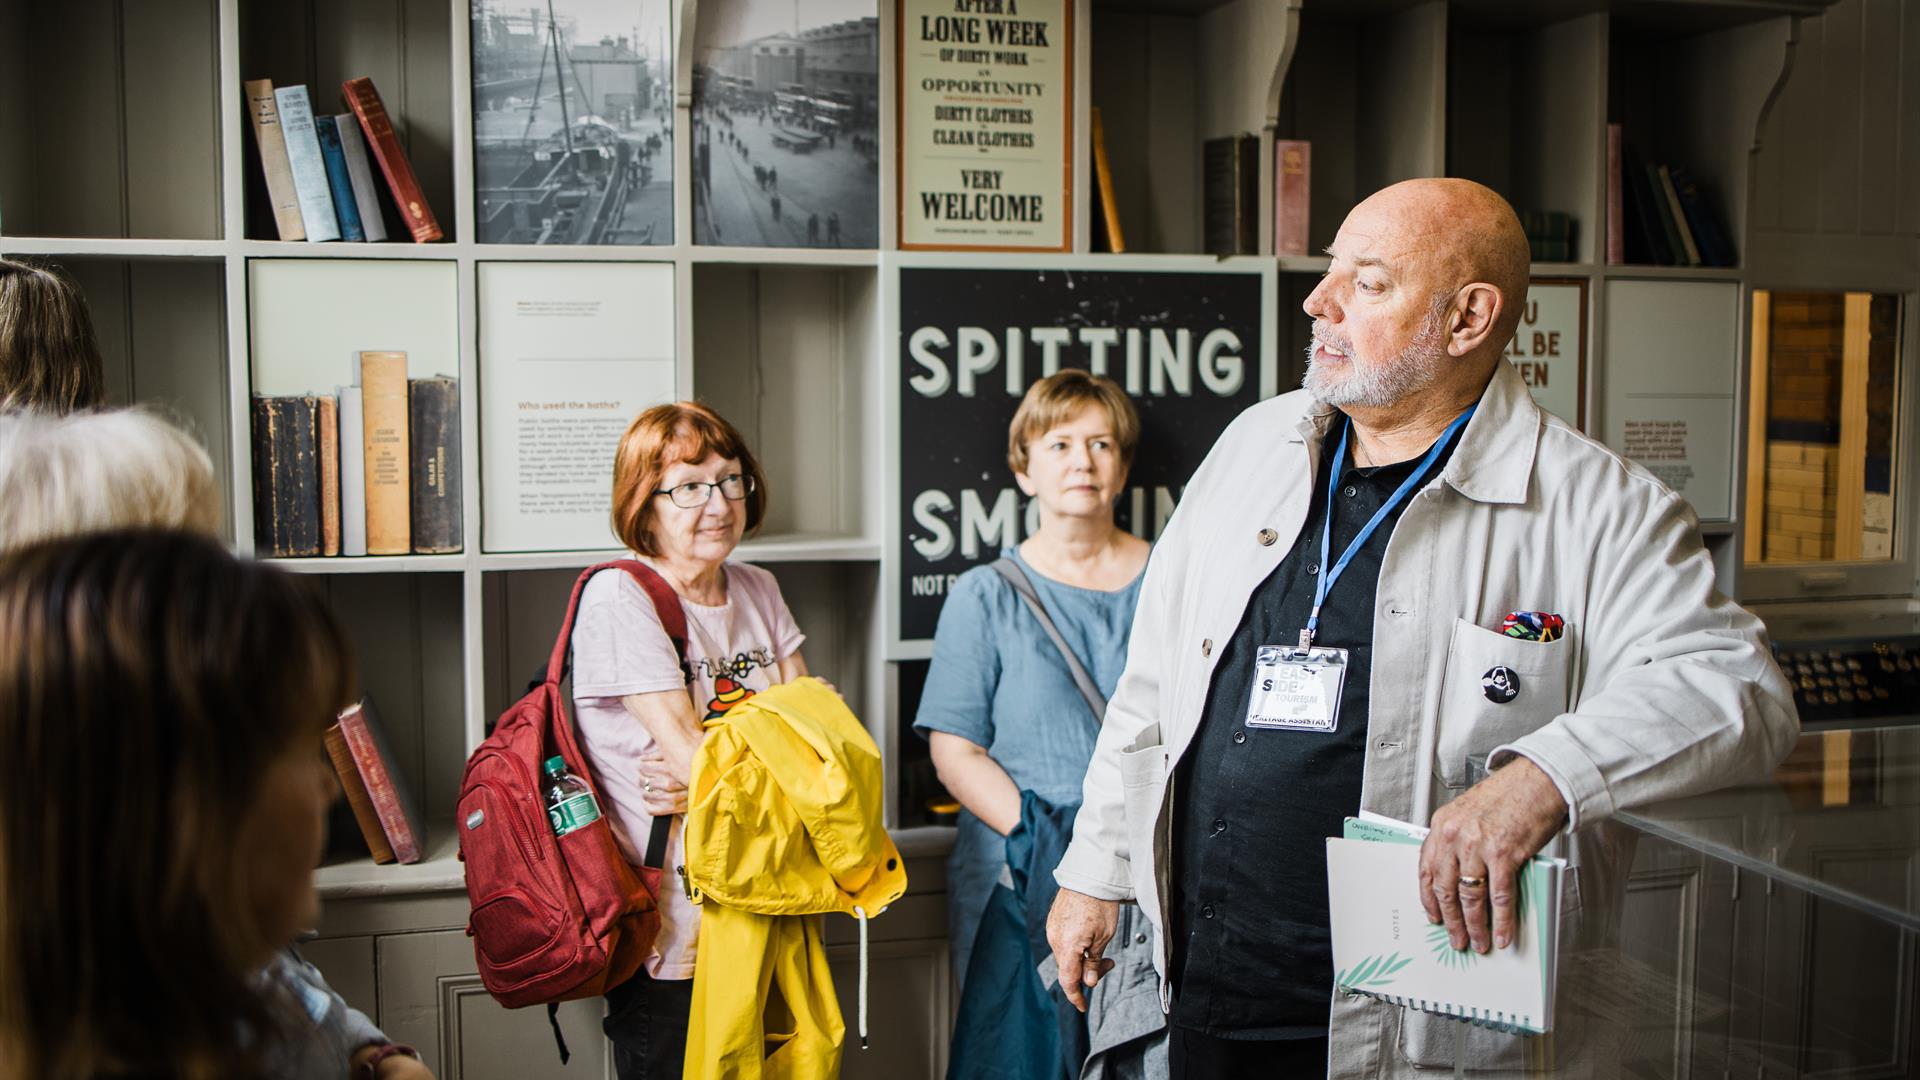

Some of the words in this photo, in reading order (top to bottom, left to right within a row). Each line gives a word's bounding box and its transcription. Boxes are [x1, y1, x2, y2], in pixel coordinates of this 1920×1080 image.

[954, 0, 1003, 14] AFTER
[1007, 0, 1017, 15] A
[921, 15, 981, 43] LONG
[986, 19, 1049, 47] WEEK
[940, 48, 954, 62] OF
[957, 49, 990, 64] DIRTY
[994, 51, 1029, 66] WORK
[921, 78, 1045, 96] OPPORTUNITY
[935, 105, 972, 122] DIRTY
[975, 106, 1033, 124] CLOTHES
[933, 129, 975, 146] CLEAN
[977, 130, 1034, 148] CLOTHES
[961, 169, 1003, 190] VERY
[921, 191, 1043, 223] WELCOME
[1533, 331, 1560, 357] BE
[909, 325, 1246, 398] SPITTING
[518, 402, 540, 410] Who
[543, 402, 566, 410] used
[568, 401, 585, 410] the
[587, 401, 620, 410] baths?
[912, 574, 945, 596] NOT
[1281, 667, 1312, 680] EAS
[1275, 694, 1318, 704] TOURISM
[1391, 908, 1400, 940] NOTES
